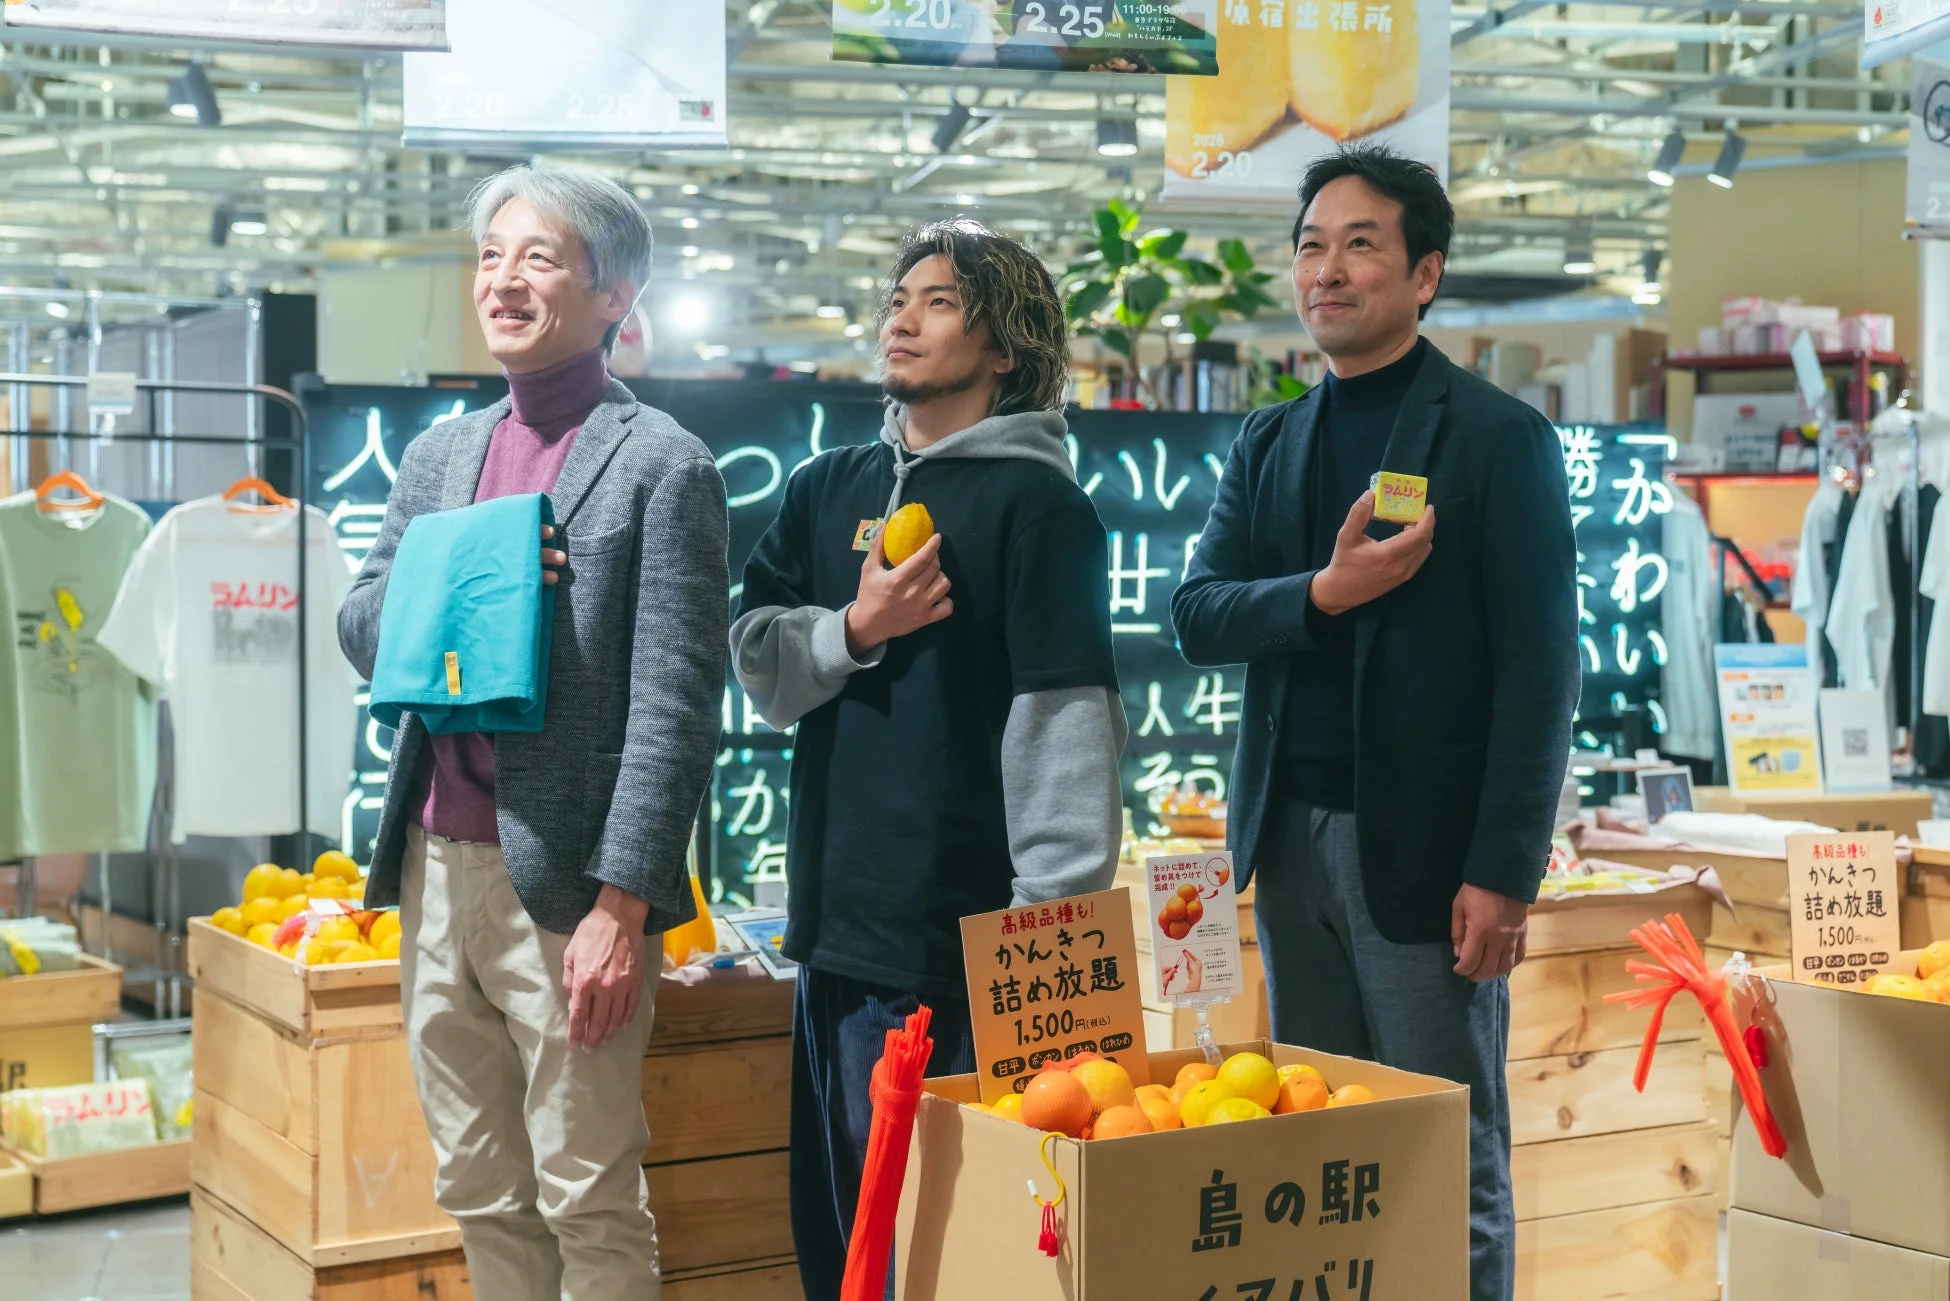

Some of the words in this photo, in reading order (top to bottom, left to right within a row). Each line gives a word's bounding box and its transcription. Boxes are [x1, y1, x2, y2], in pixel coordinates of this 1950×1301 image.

[869, 0, 951, 29] 2.20
[1025, 2, 1104, 38] 2.25
[1224, 0, 1393, 33] 原宿出張所
[1193, 134, 1225, 147] 2026
[1191, 151, 1252, 178] 2.20
[1809, 862, 1877, 887] かんきつ
[1001, 900, 1095, 935] 高級品種も!
[1804, 890, 1887, 920] 詰め放題
[996, 928, 1105, 970] かんきつ
[989, 956, 1125, 1016] 詰め放題
[998, 1059, 1021, 1075] 甘平
[1191, 1159, 1381, 1253] 島の駅
